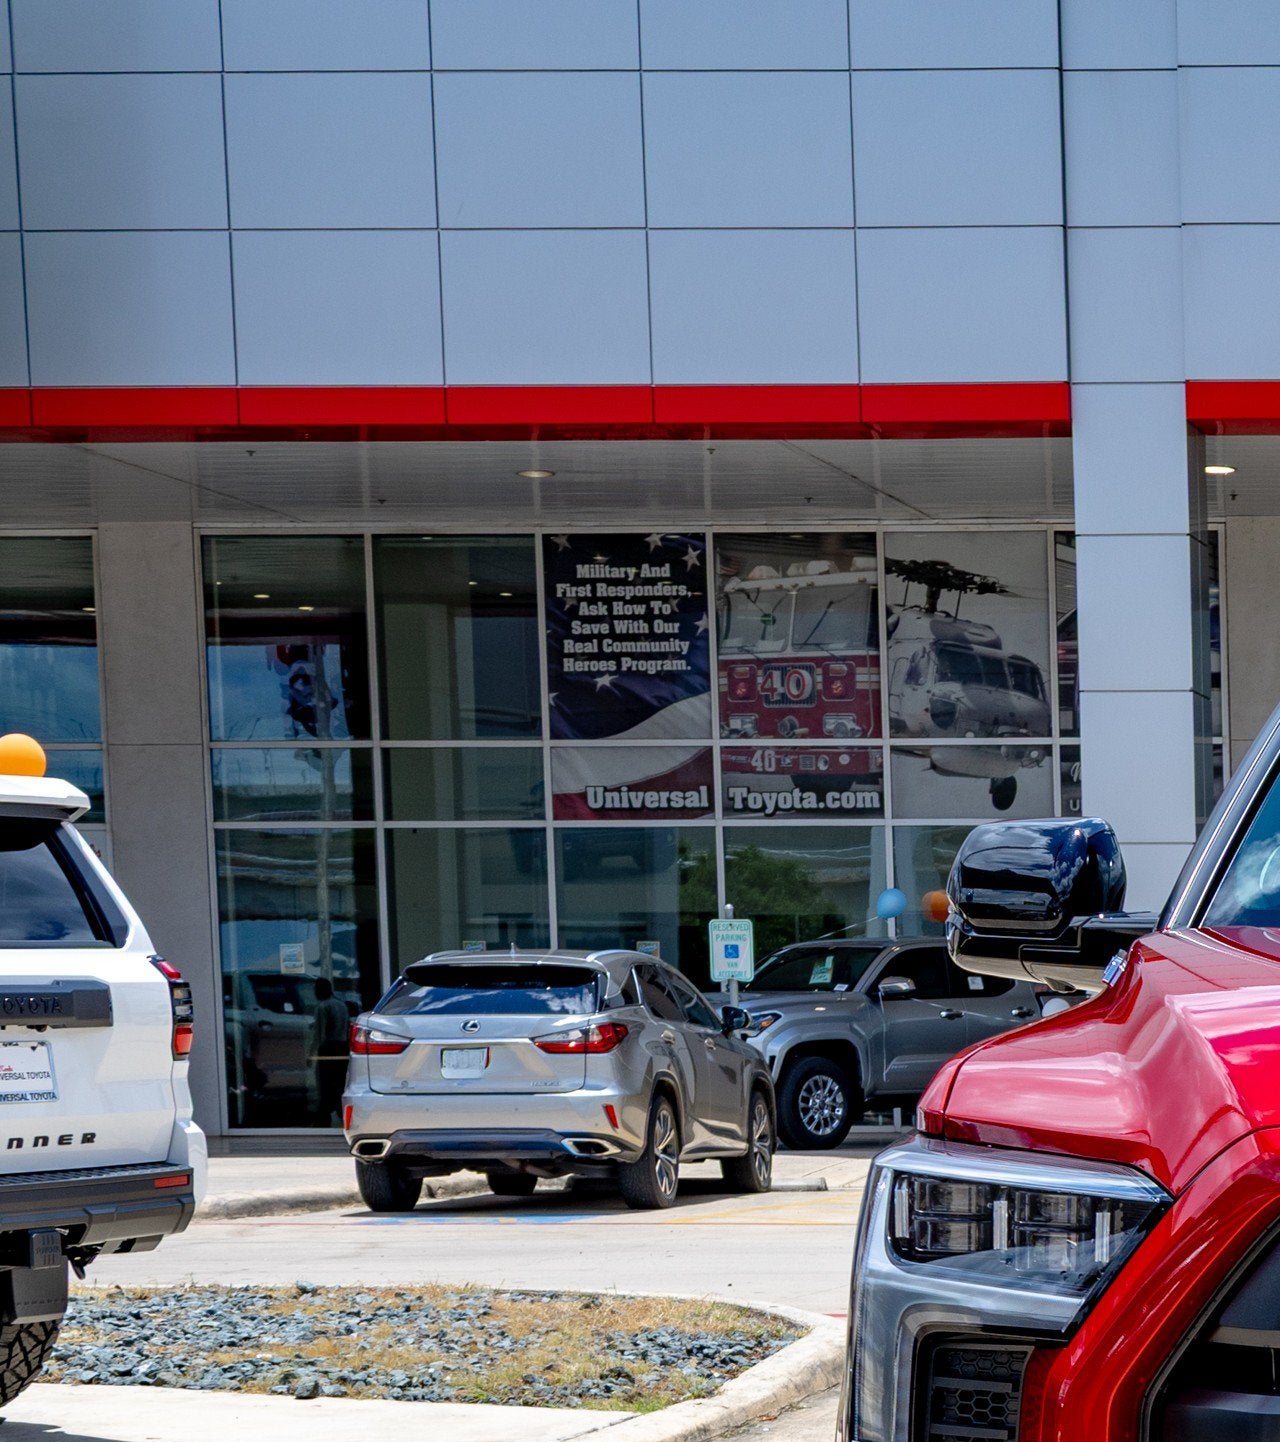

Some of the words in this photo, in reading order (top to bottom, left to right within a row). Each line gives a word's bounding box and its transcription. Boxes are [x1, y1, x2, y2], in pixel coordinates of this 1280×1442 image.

[576, 564, 636, 581] Military
[640, 563, 670, 577] And
[556, 583, 592, 597] First
[596, 582, 692, 600] Responders,
[579, 601, 608, 616] Ask
[612, 601, 646, 615] How
[650, 600, 671, 614] To
[571, 620, 609, 634] Save
[613, 619, 649, 634] With
[653, 619, 680, 633] Our
[563, 639, 598, 653] Real
[602, 638, 690, 655] Community
[563, 657, 617, 672] Heroes
[621, 656, 691, 674] Program.
[759, 668, 812, 701] 40
[750, 750, 776, 772] 40
[585, 785, 709, 809] Universal
[728, 786, 881, 816] Toyota.com
[715, 934, 747, 942] PARKING
[26, 1071, 51, 1080] TOYOTA
[29, 1091, 57, 1101] TOYOTA
[7, 1132, 97, 1149] NNER
